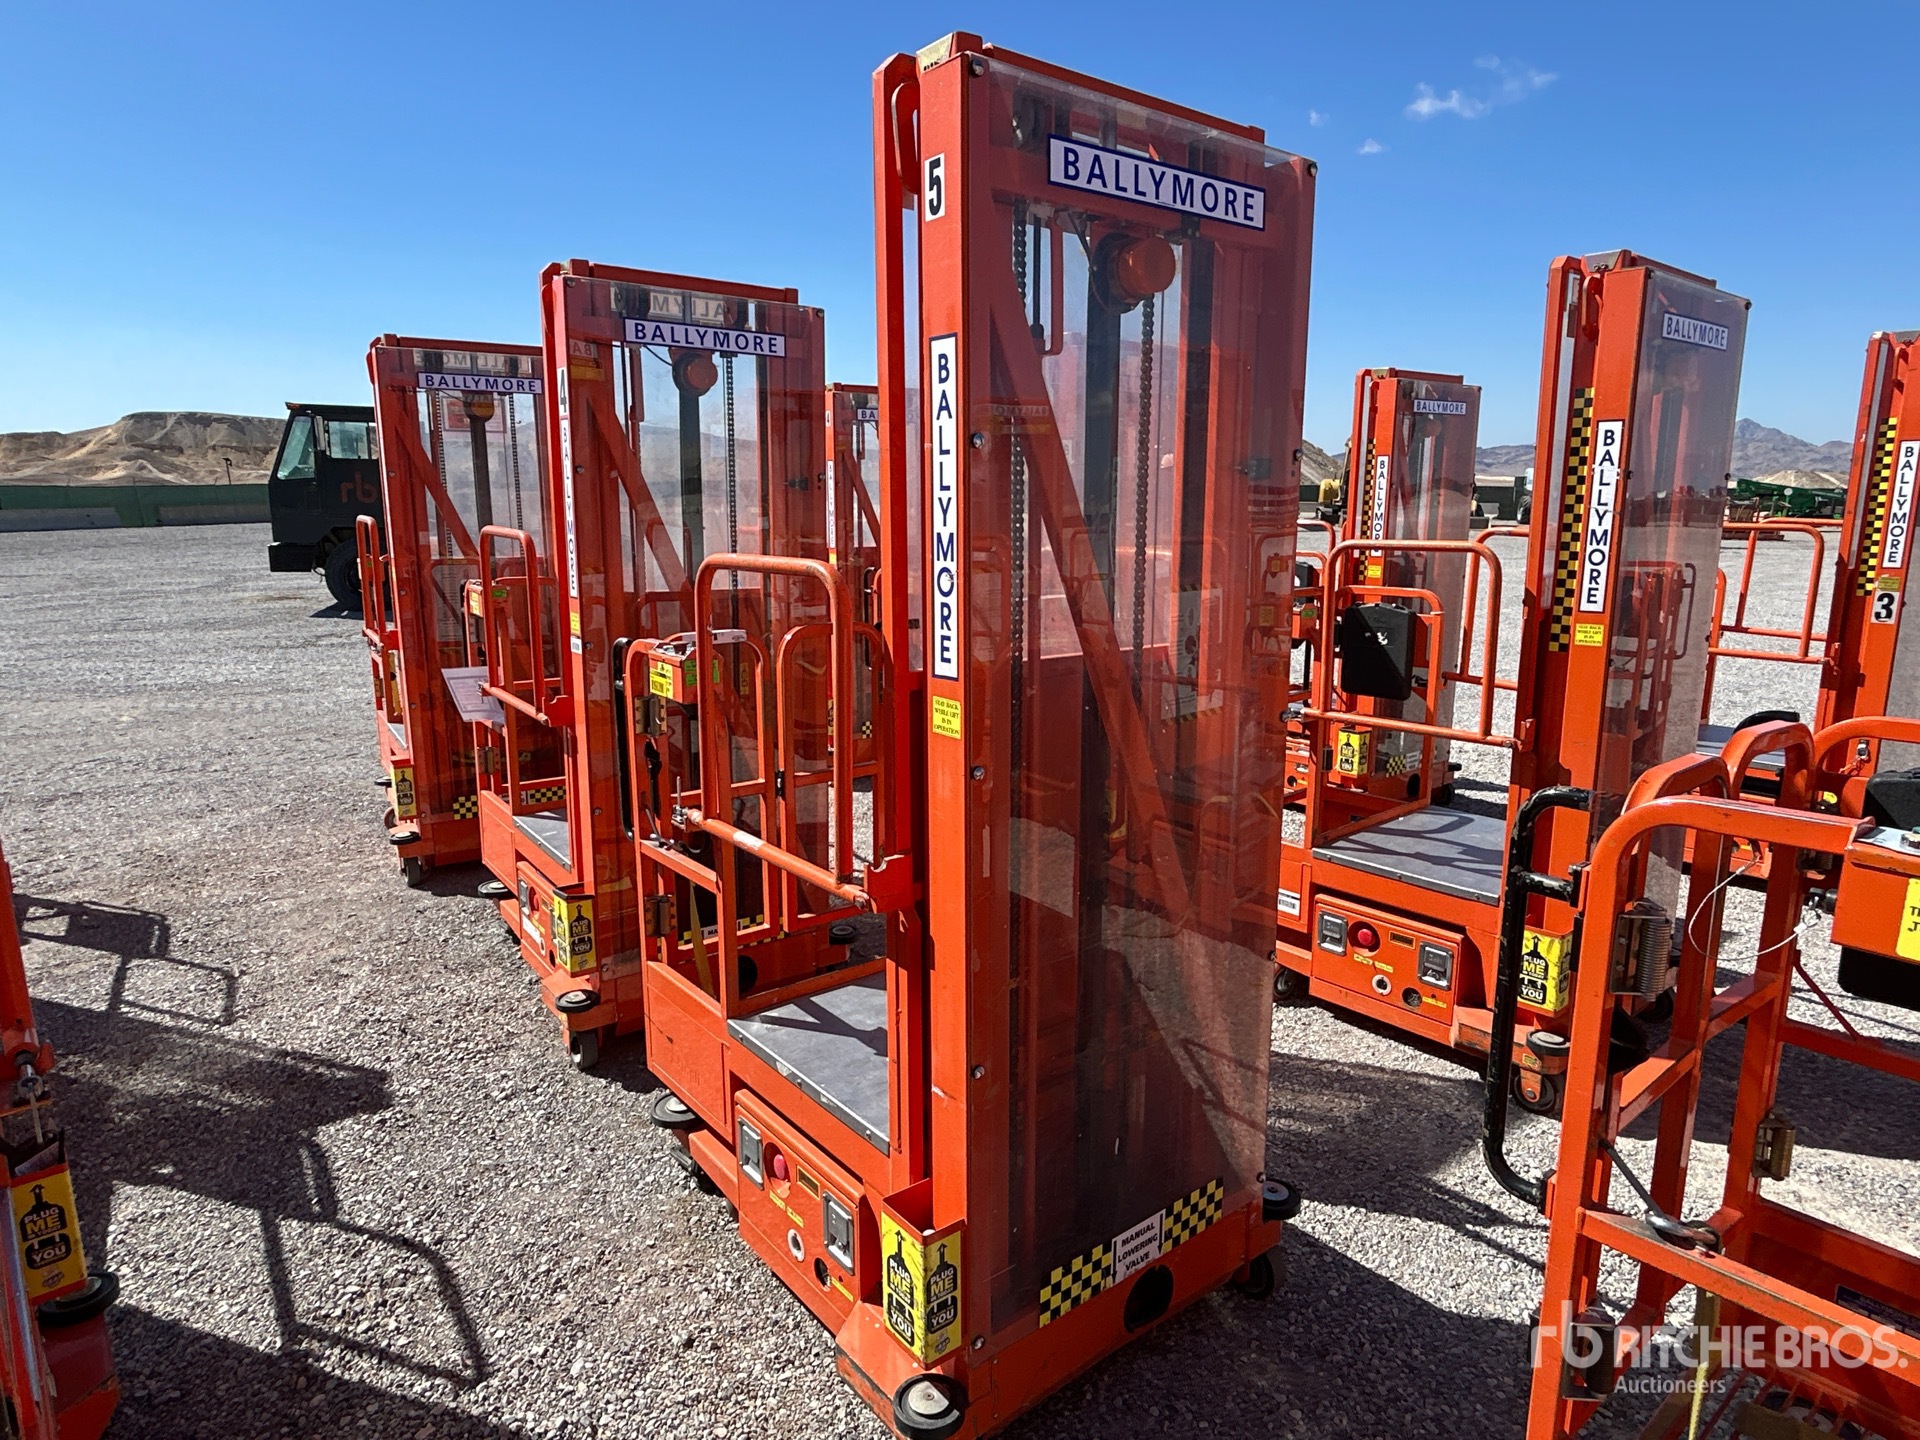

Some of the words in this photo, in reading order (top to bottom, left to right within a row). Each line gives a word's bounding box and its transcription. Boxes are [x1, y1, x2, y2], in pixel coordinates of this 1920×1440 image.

[927, 157, 942, 217] 5
[1063, 146, 1255, 222] BALLYMORE
[634, 322, 778, 354] BALLYMORE
[1665, 316, 1726, 347] BALLYMORE
[425, 374, 536, 392] BALLYMORE
[559, 369, 567, 413] 4
[1416, 401, 1464, 413] BALLYMORE
[340, 472, 378, 503] rb
[936, 353, 954, 664] BALLYMORE
[1374, 460, 1386, 552] BALLYMOR
[1888, 446, 1914, 563] BALLYMORE
[1586, 429, 1615, 605] BALLYMORE
[1874, 592, 1895, 622] 3
[573, 924, 589, 934] ME
[574, 943, 591, 952] YOU
[1523, 955, 1546, 967] PLUG
[1523, 961, 1545, 976] ME
[1521, 987, 1543, 1000] YOU
[24, 1207, 59, 1223] PLUG
[25, 1214, 60, 1234] ME
[1120, 1222, 1155, 1247] MANUAL
[32, 1245, 66, 1262] YOU
[1117, 1233, 1158, 1262] LOWERING
[889, 1258, 911, 1283] PLUG
[1125, 1251, 1150, 1271] VALVE
[890, 1271, 911, 1295] ME
[930, 1267, 954, 1285] PLUG
[931, 1277, 954, 1296] ME
[890, 1312, 913, 1337] YOU
[931, 1308, 955, 1327] YOU
